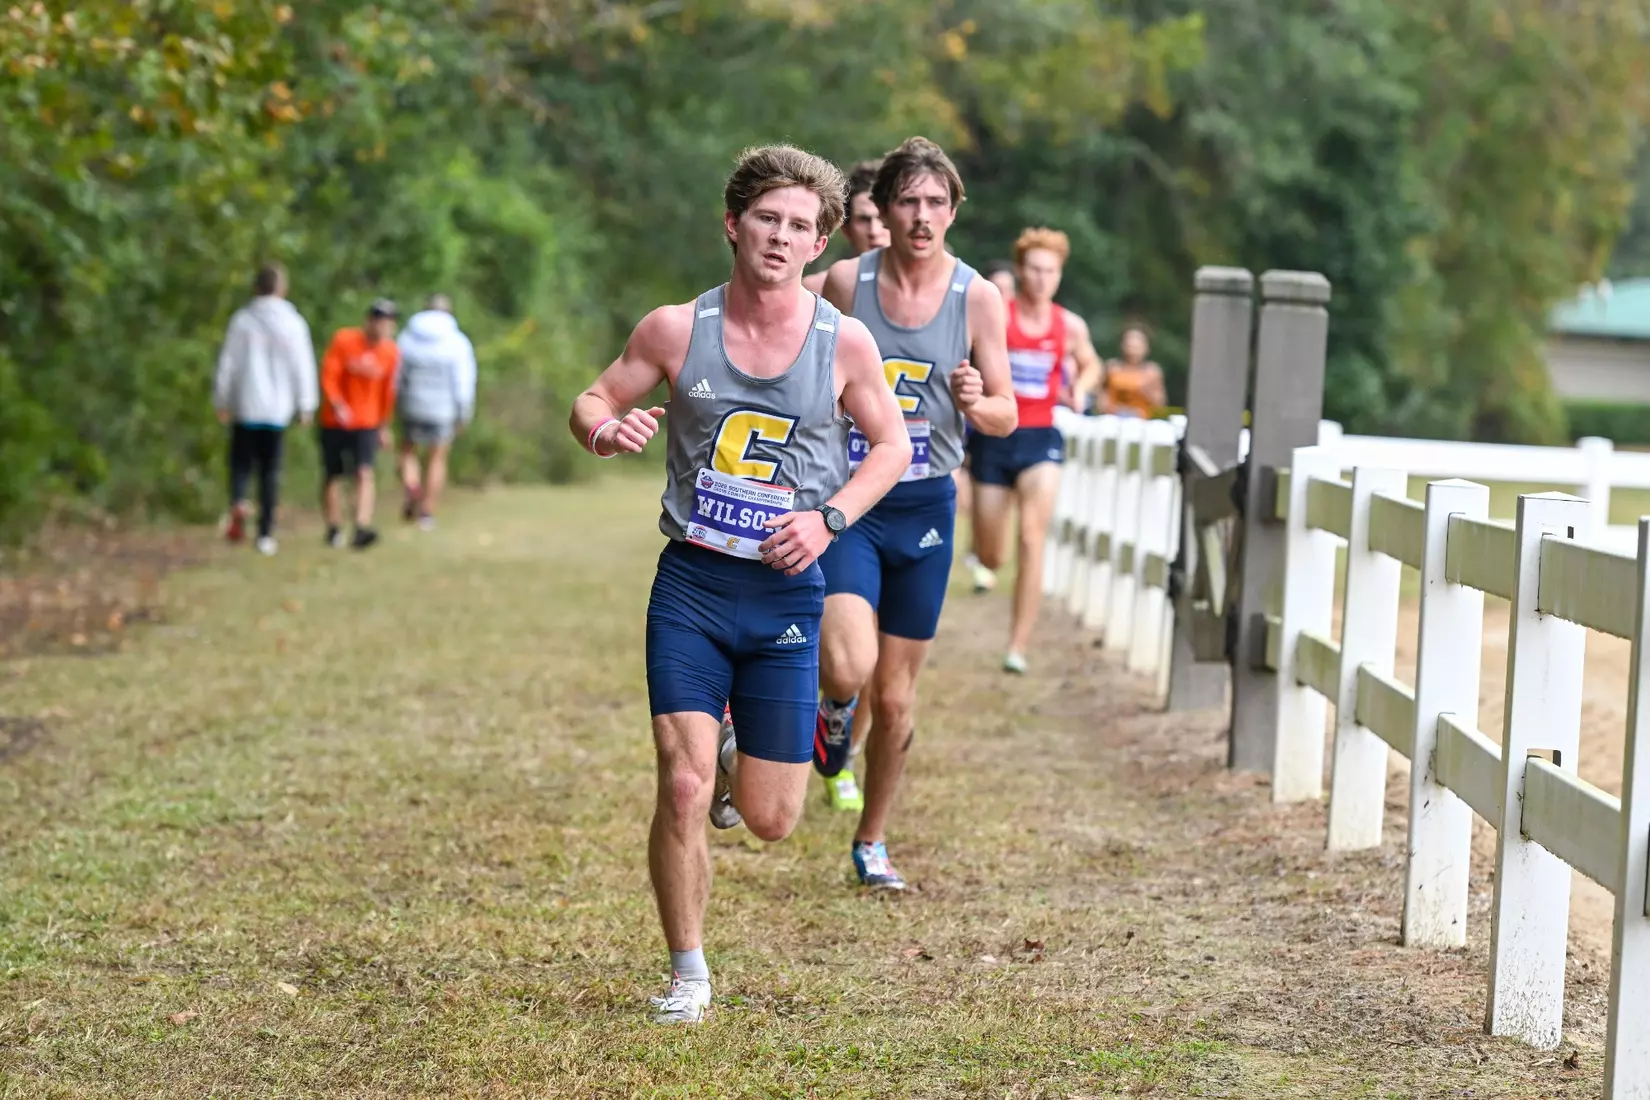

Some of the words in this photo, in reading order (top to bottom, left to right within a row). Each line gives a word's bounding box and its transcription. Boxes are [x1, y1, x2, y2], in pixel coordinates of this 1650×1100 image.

[688, 390, 716, 400] adidas
[708, 406, 801, 484] C
[729, 485, 756, 497] SOUTHERN
[757, 492, 791, 503] CONFERENCE
[776, 635, 807, 645] adidas
